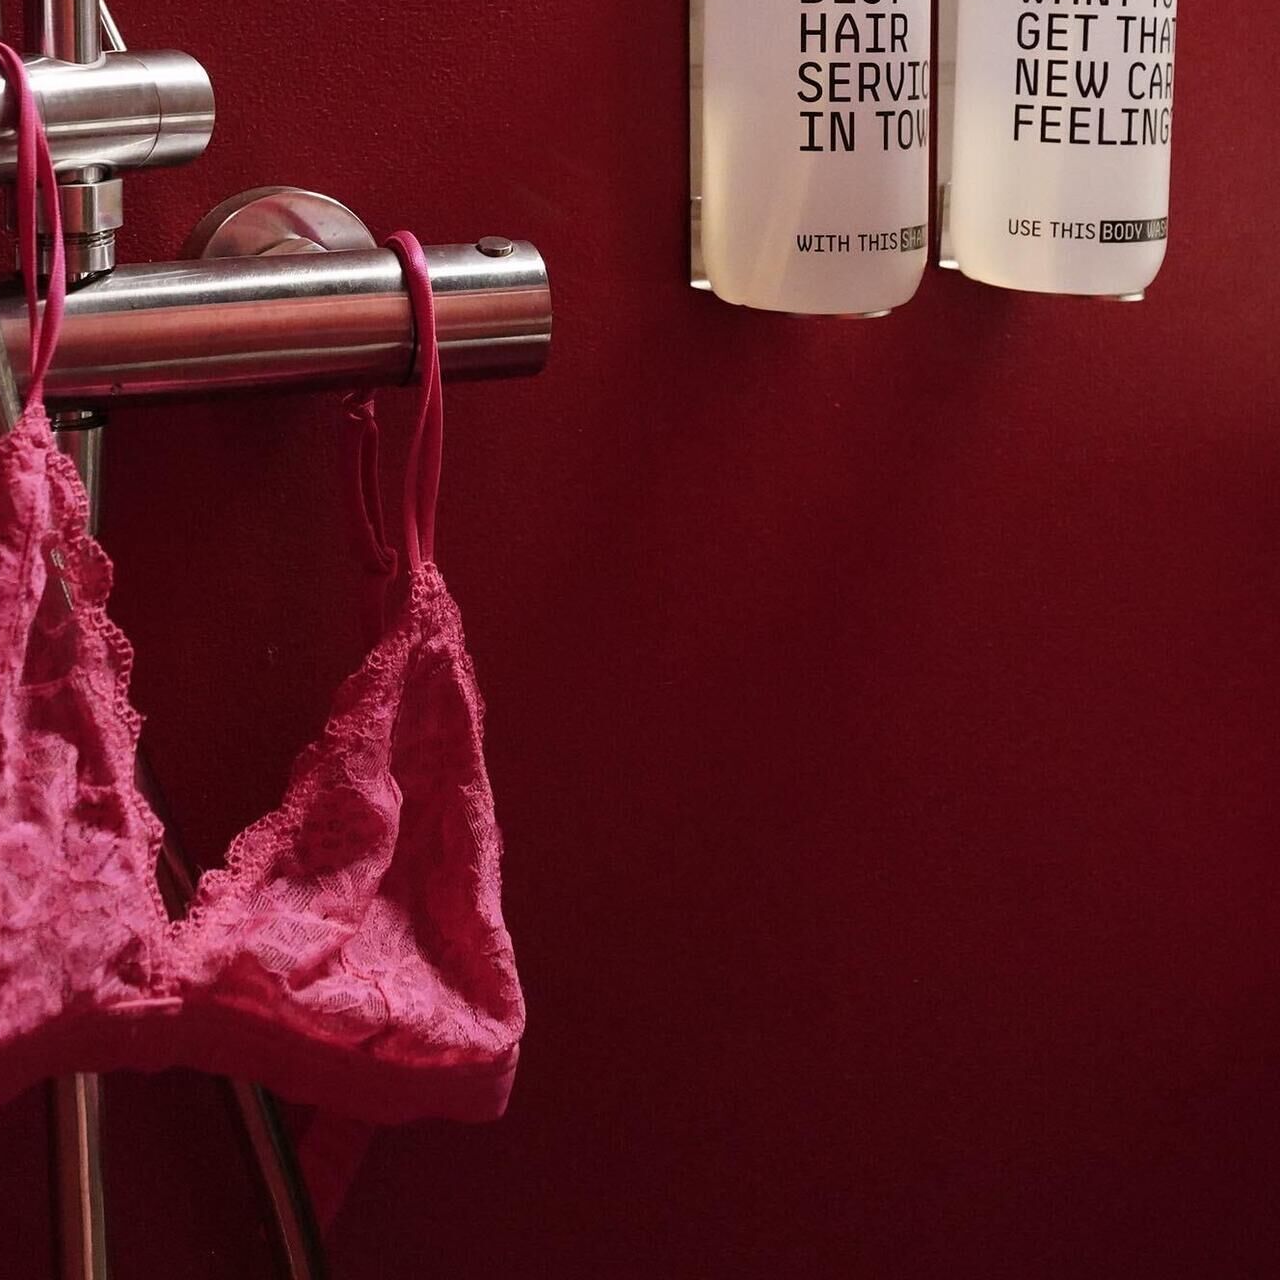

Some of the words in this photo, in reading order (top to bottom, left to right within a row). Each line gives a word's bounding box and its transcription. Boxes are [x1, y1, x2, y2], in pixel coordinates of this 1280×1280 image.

[799, 13, 909, 53] HAIR
[1016, 12, 1098, 52] GET
[1015, 58, 1109, 99] NEW
[1128, 61, 1172, 101] CAR
[799, 111, 855, 152] IN
[1014, 105, 1171, 146] FEELING
[797, 233, 850, 253] WITH
[857, 232, 899, 251] THIS
[902, 227, 925, 249] SHA
[1008, 218, 1041, 237] USE
[1050, 221, 1096, 240] THIS
[1102, 223, 1143, 241] BODY
